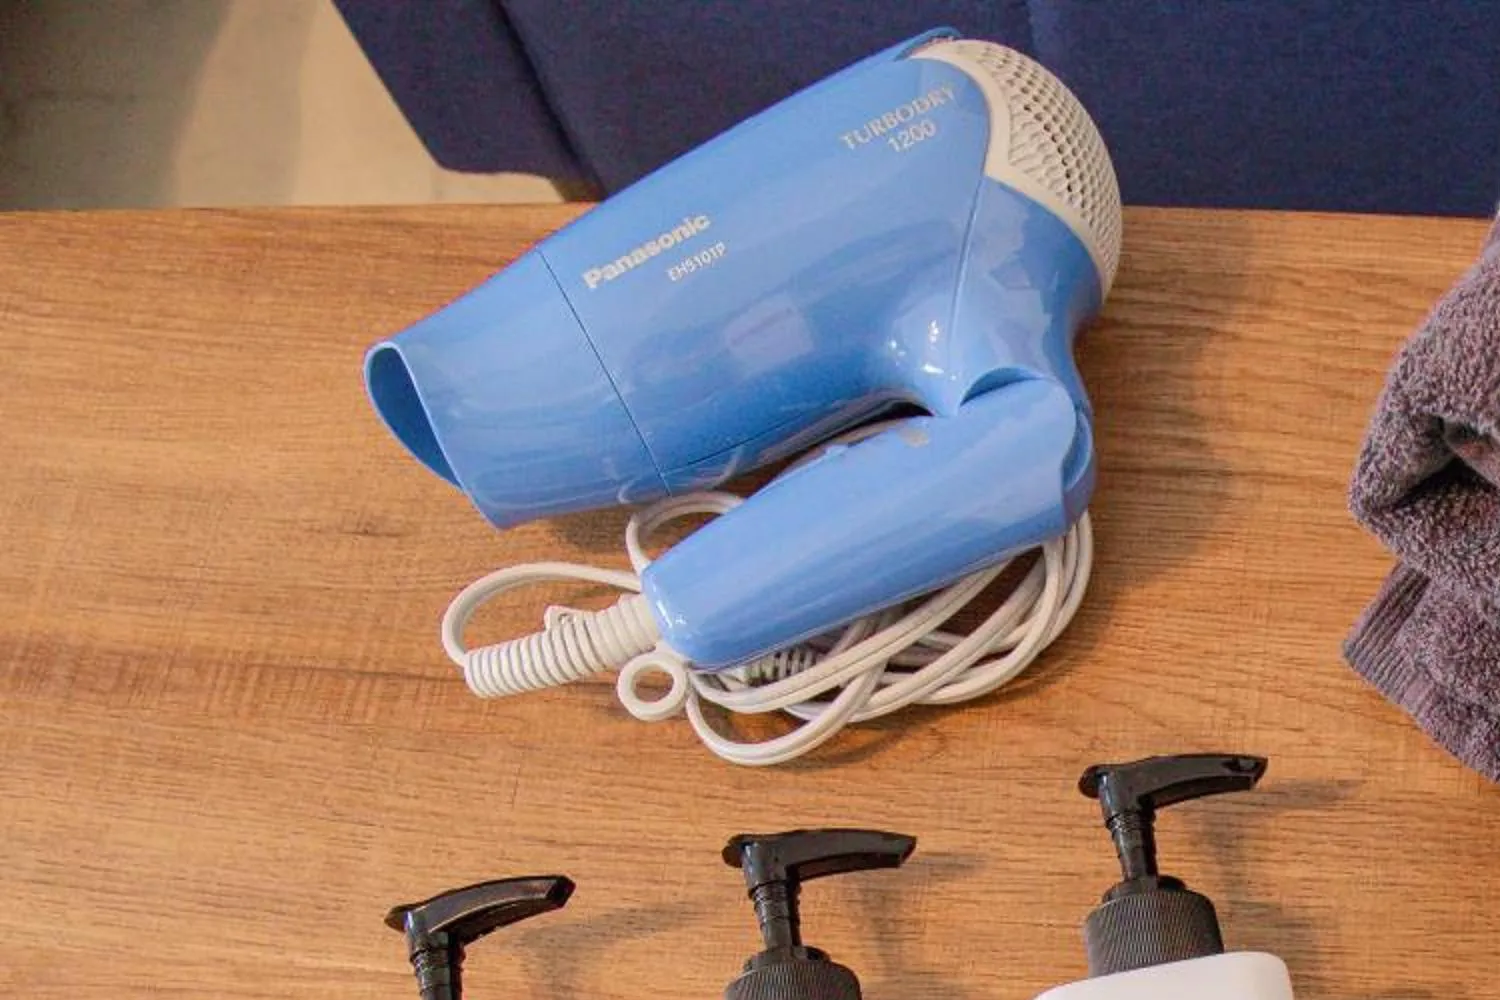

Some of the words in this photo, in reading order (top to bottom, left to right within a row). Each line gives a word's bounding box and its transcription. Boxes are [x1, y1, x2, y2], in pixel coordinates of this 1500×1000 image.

[839, 86, 955, 150] TURBODRY
[888, 119, 936, 153] 1200
[583, 212, 711, 289] Panasonic
